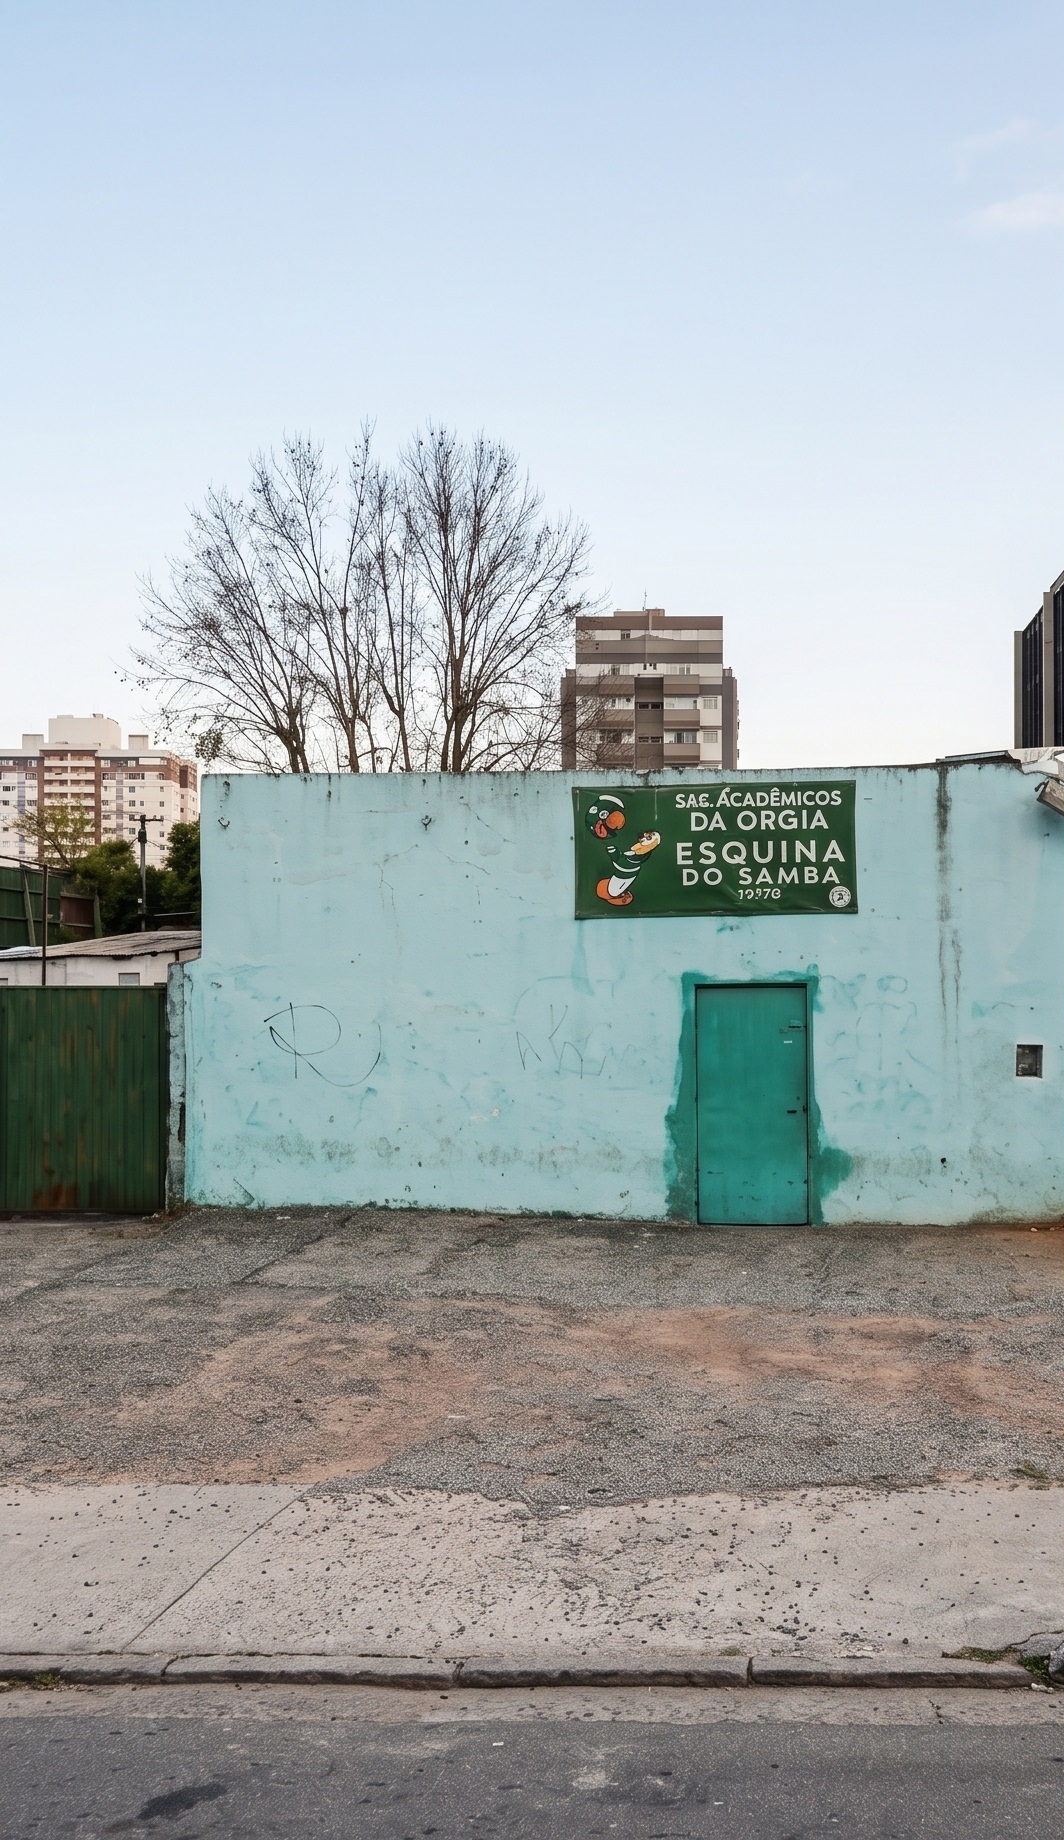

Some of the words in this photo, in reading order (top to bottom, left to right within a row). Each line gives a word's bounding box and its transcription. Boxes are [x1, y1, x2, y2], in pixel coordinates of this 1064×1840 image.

[690, 811, 727, 831] DA
[737, 809, 829, 831] ORGIA
[676, 840, 846, 865] ESQUINA
[682, 868, 723, 886] DO
[738, 866, 841, 885] SAMBA
